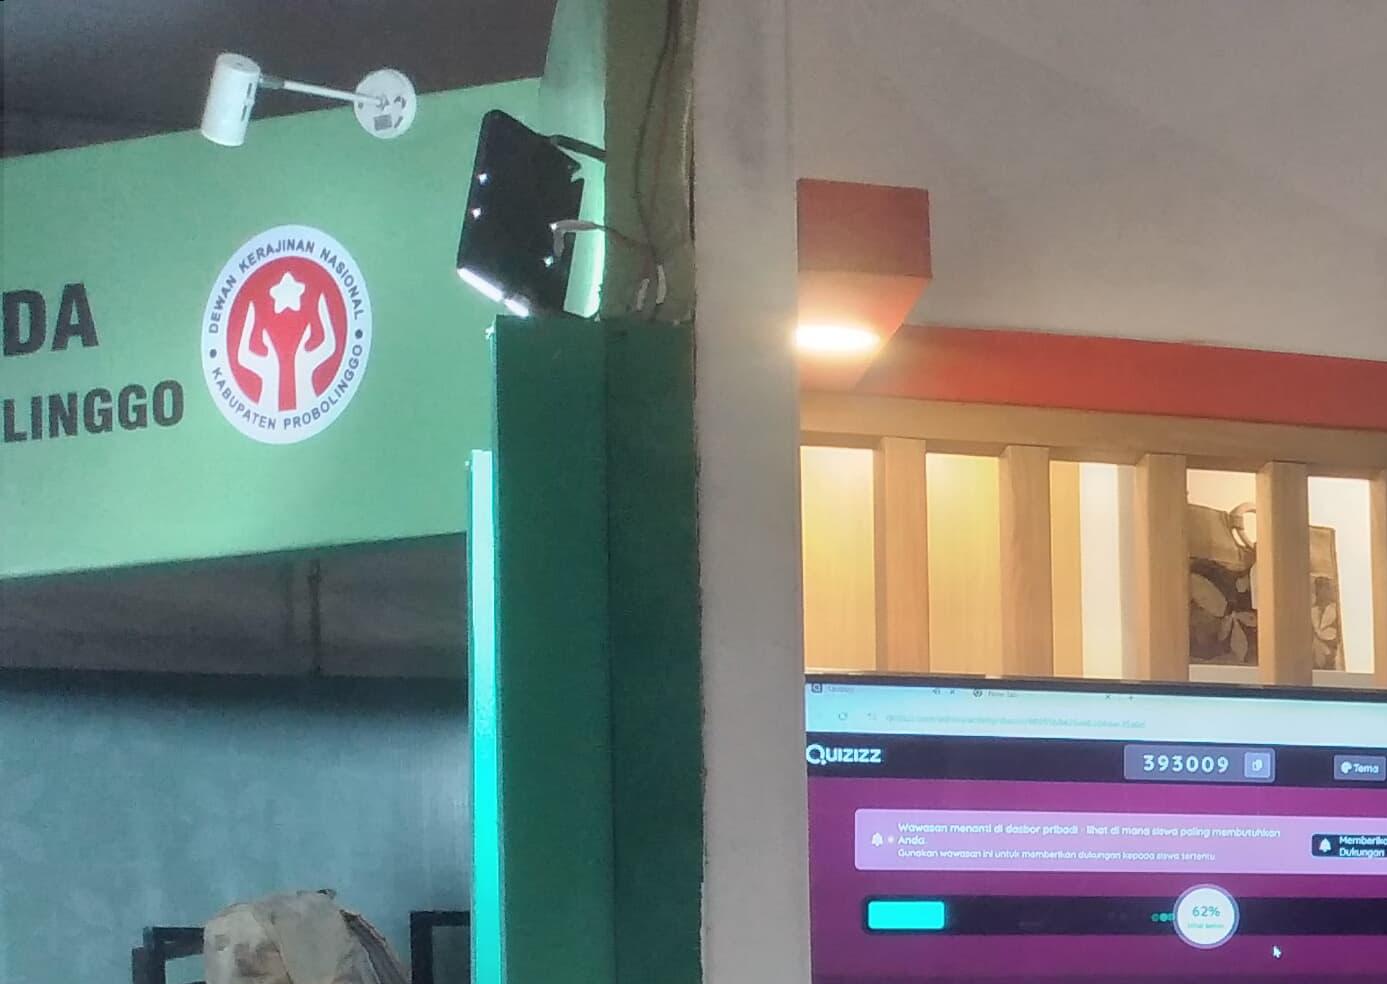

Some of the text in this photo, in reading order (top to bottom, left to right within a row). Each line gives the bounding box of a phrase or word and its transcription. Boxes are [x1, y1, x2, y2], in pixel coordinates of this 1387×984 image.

[208, 238, 366, 334] DEWAN KERAJINAN NASIONAL
[211, 344, 363, 431] KABUPATEN PROBOLINGGO
[1143, 754, 1229, 773] 393009
[1353, 762, 1379, 774] Tema
[898, 823, 947, 833] Wawasan
[898, 848, 938, 858] Gunakan
[1339, 847, 1385, 858] Dukungan
[1192, 905, 1221, 917] 62%
